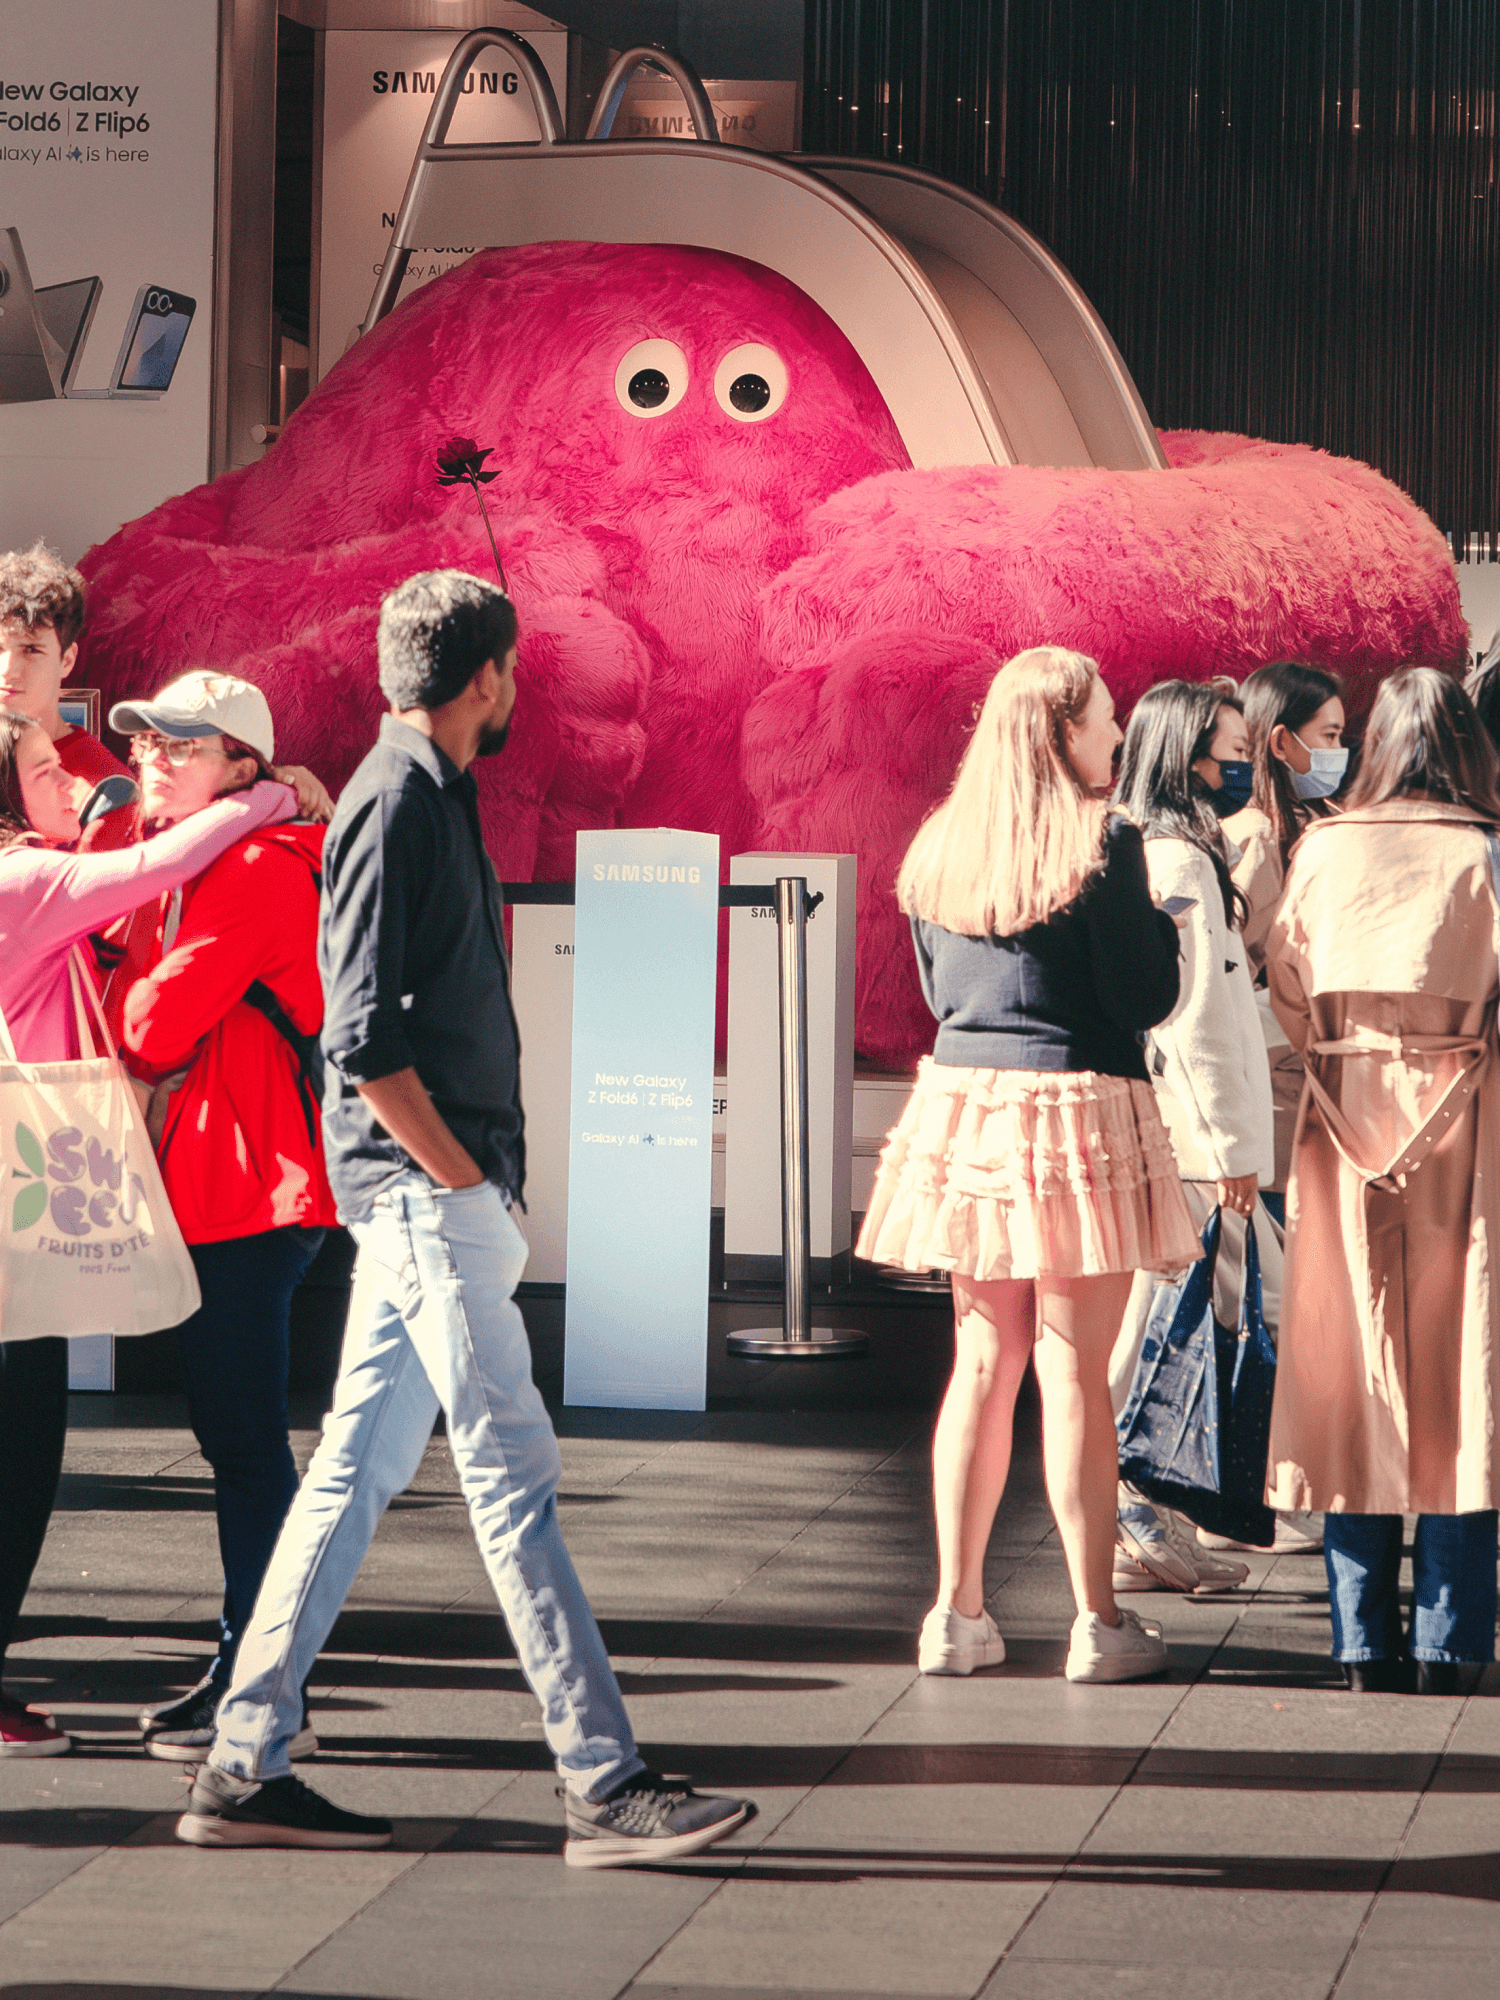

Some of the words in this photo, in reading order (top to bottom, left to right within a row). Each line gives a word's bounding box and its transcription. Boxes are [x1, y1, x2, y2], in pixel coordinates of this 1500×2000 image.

[373, 70, 518, 95] SAMUNG
[49, 81, 140, 107] Galaxy
[75, 112, 89, 132] Z
[95, 111, 150, 139] Flip6
[0, 146, 41, 165] laxy
[46, 146, 62, 161] AI
[86, 146, 100, 162] is
[106, 146, 150, 162] here
[592, 863, 701, 884] SAMSUNG
[595, 1073, 629, 1086] New
[633, 1074, 687, 1092] Galaxy
[587, 1090, 597, 1104] Z
[600, 1091, 638, 1105] Fold6
[648, 1092, 657, 1106] Z
[660, 1092, 693, 1110] Flip6
[581, 1131, 625, 1146] Galaxy
[628, 1134, 639, 1145] AI
[657, 1134, 666, 1145] is
[669, 1134, 698, 1147] here
[37, 1236, 105, 1259] FRUITS
